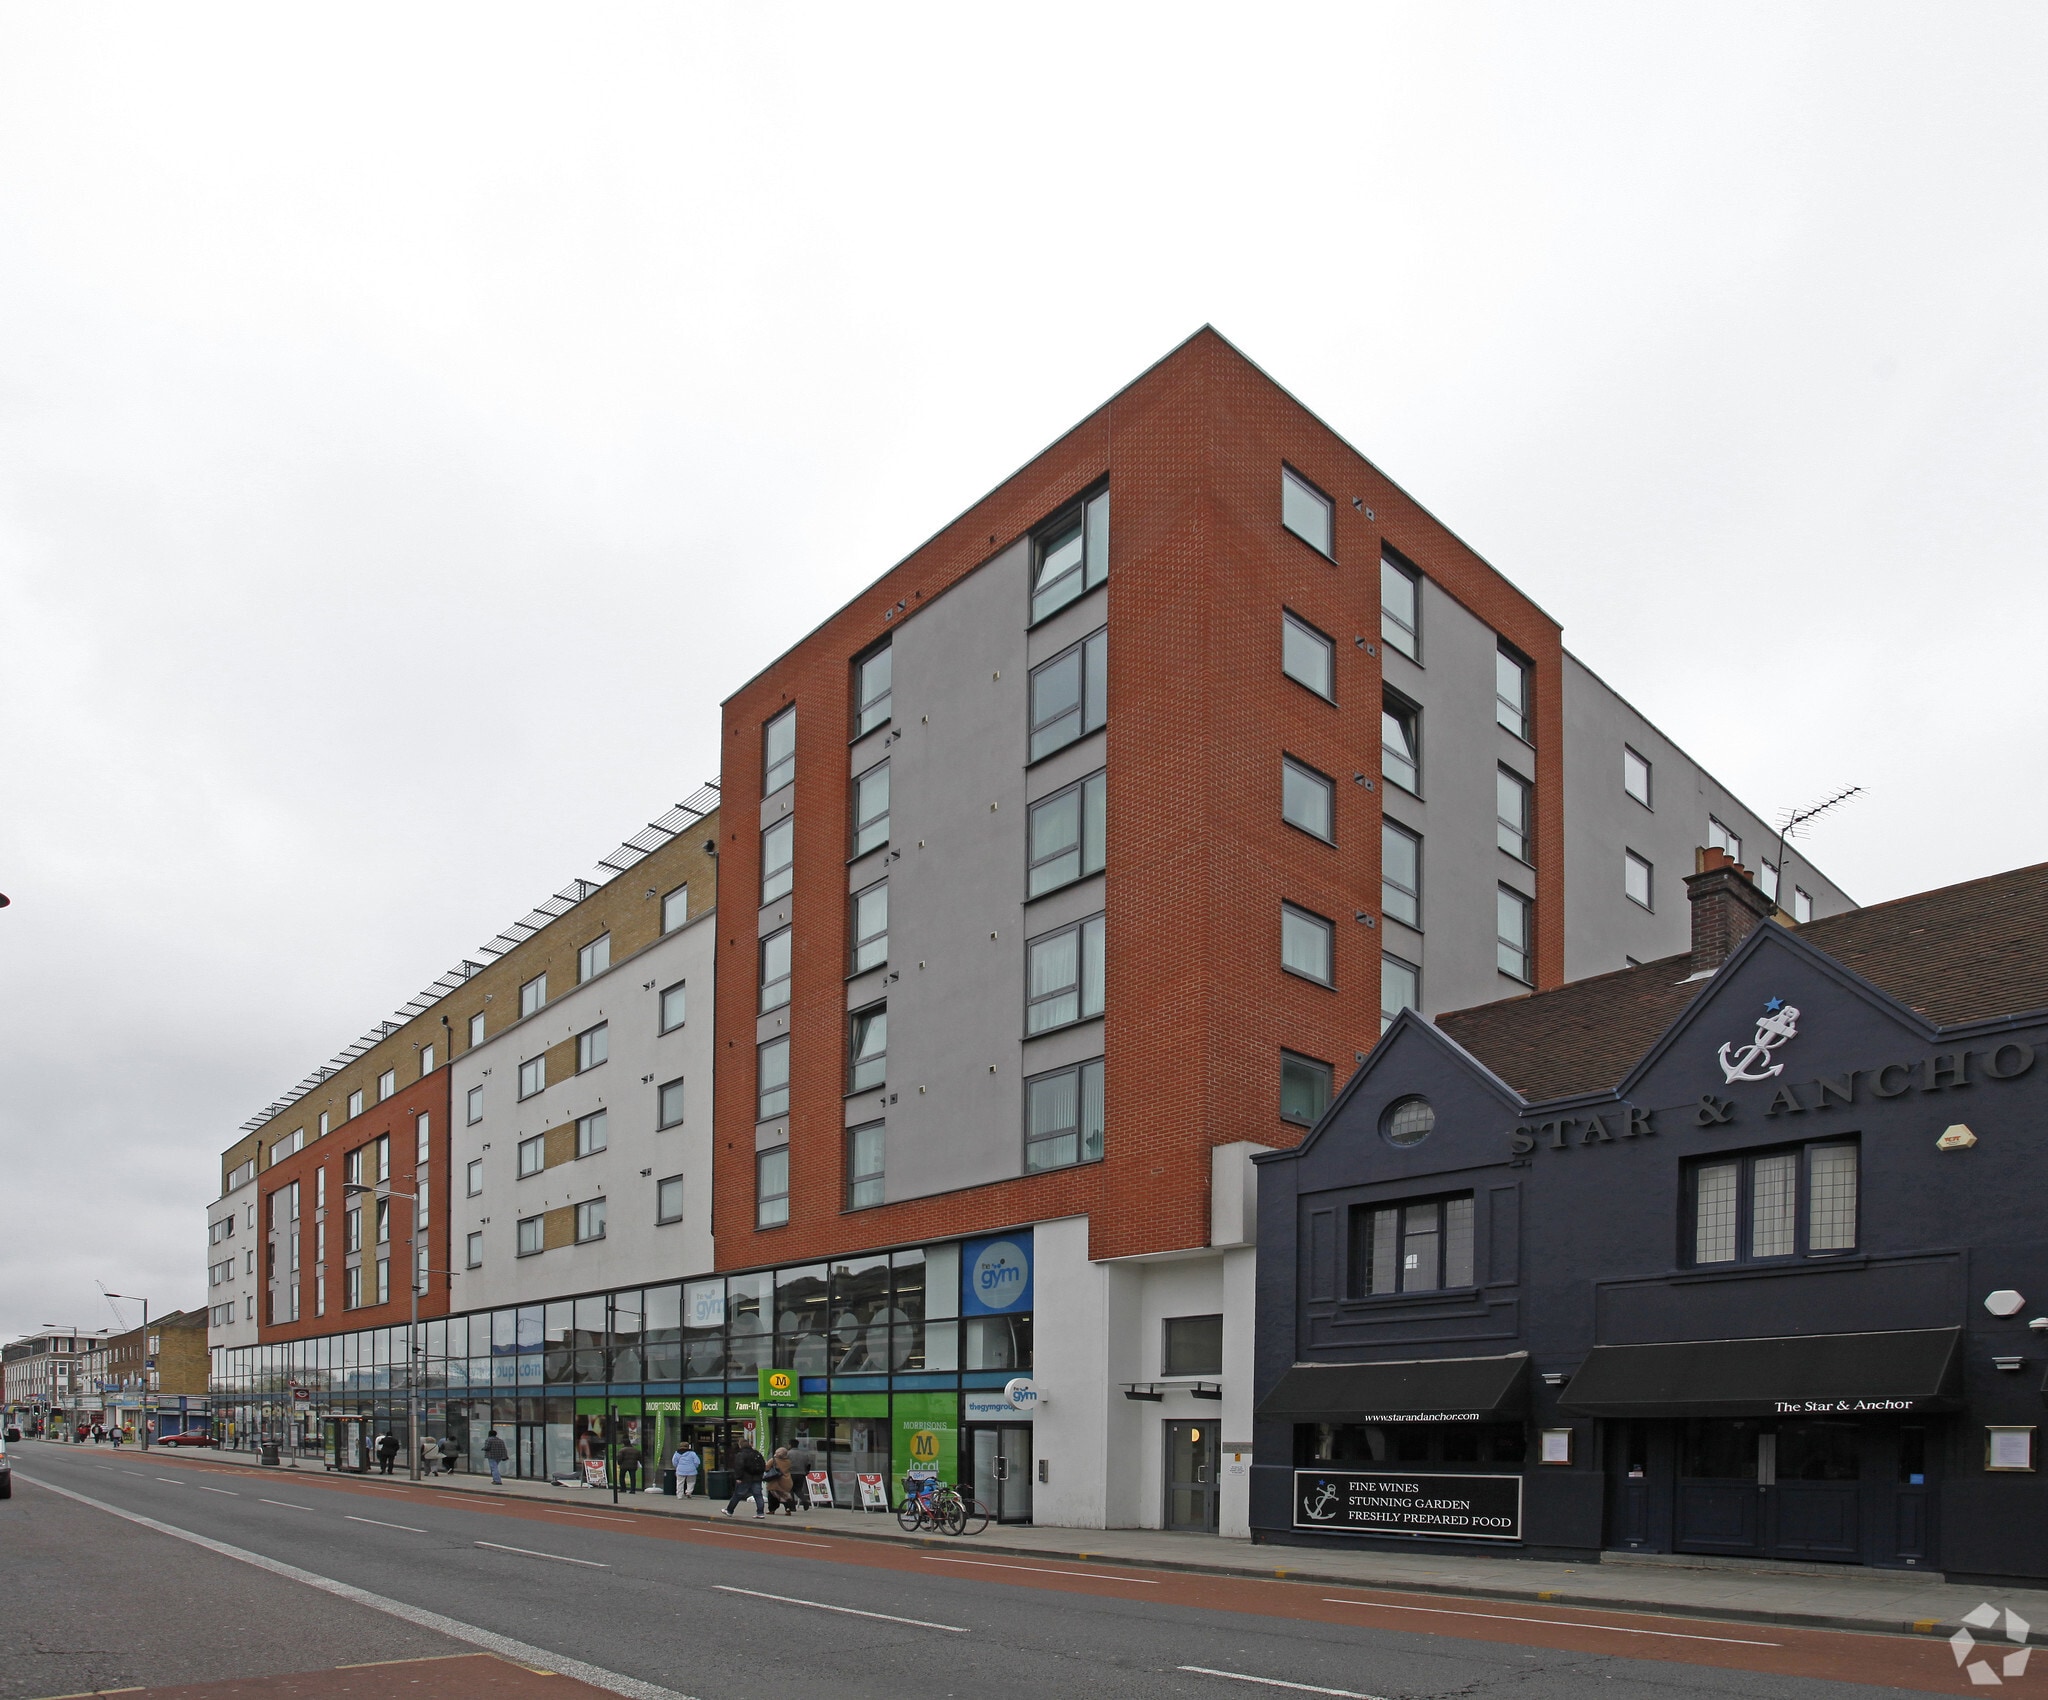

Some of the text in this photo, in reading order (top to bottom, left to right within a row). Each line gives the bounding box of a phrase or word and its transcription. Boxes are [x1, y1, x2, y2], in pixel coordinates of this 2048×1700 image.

[1511, 1042, 2036, 1155] STAR & ANCHO
[981, 1262, 991, 1270] the
[981, 1266, 1020, 1290] gym
[696, 1299, 725, 1321] gym
[775, 1376, 787, 1386] M
[770, 1389, 791, 1397] local
[1012, 1391, 1037, 1402] gym
[645, 1401, 681, 1411] MORSONS
[702, 1402, 719, 1411] local
[1775, 1400, 1914, 1412] The Star & Anchor
[1364, 1411, 1480, 1422] www.starandanchor.com
[903, 1421, 948, 1430] MORRISONS
[915, 1435, 934, 1456] M
[909, 1458, 939, 1471] local
[1348, 1481, 1420, 1493] FINE WINES
[1348, 1496, 1471, 1510] STUNNING GARDEN
[1348, 1511, 1512, 1528] FRESHLY PREPARED FOOD
